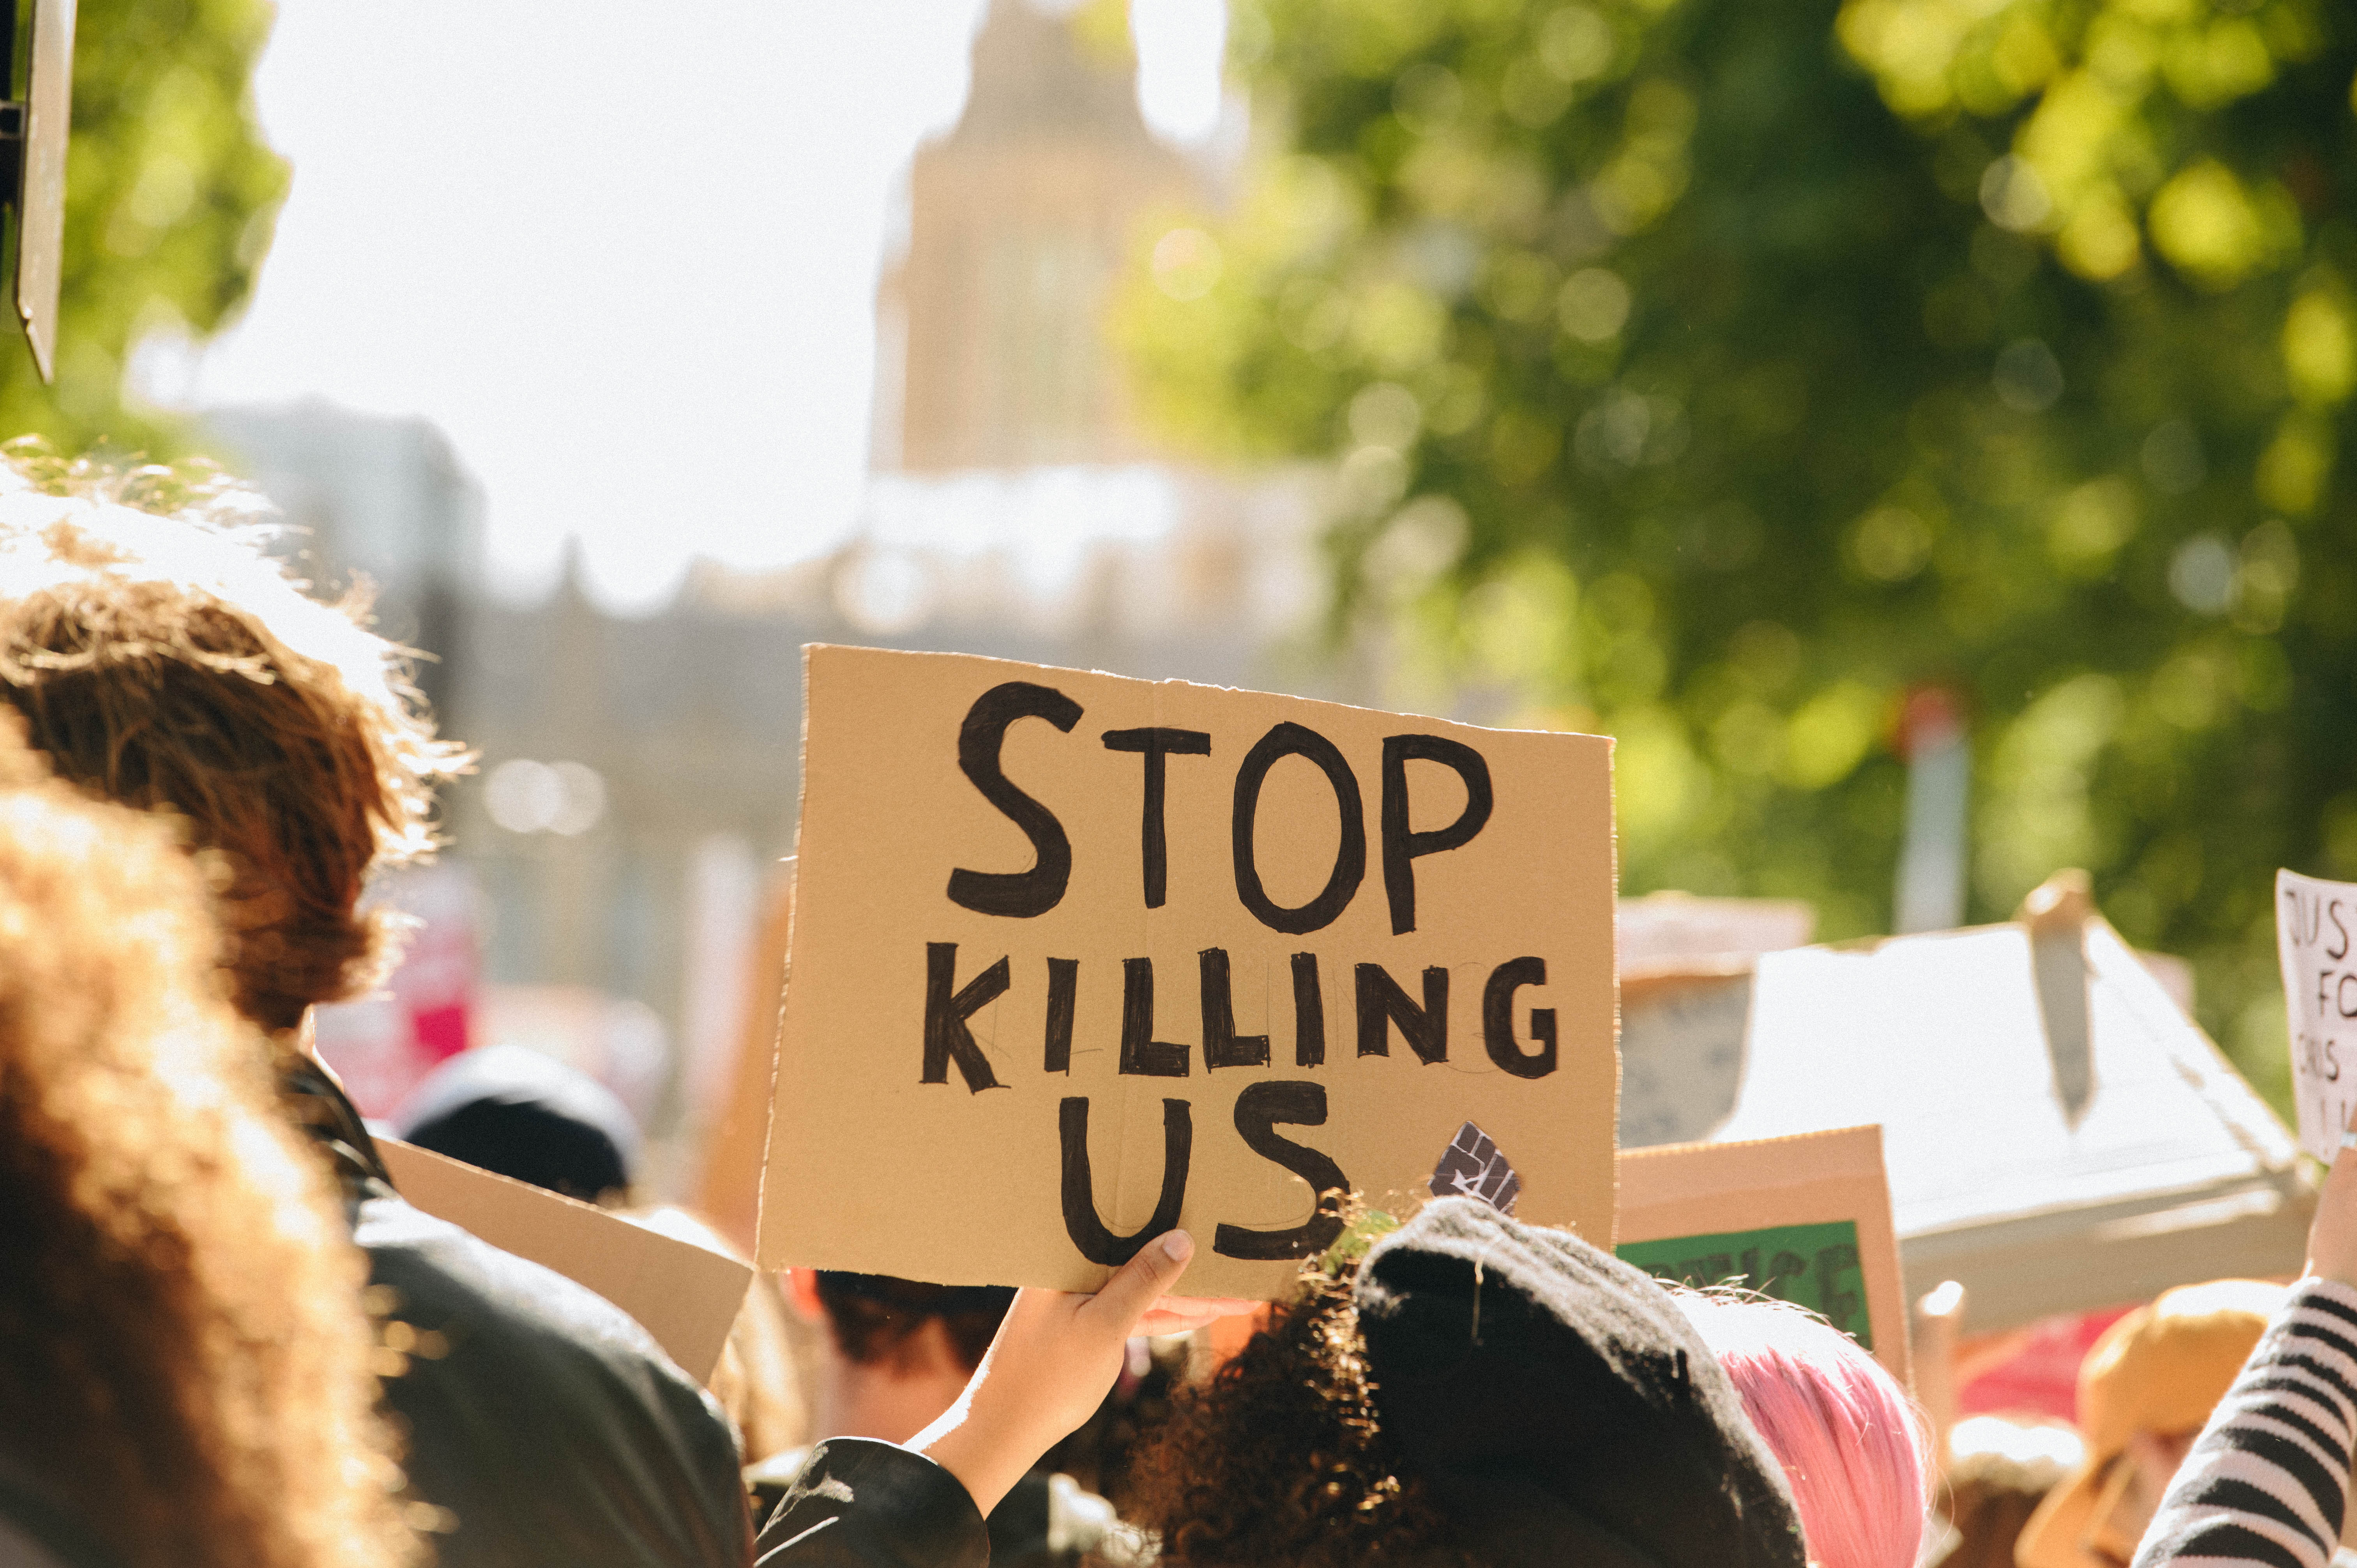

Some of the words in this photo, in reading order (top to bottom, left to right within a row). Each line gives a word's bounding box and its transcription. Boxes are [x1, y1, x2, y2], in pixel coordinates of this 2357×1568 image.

[947, 682, 1493, 936] STOP
[2283, 887, 2357, 965] JUS
[920, 942, 1557, 1093] KILLING
[1059, 1082, 1350, 1265] US
[1640, 1241, 1872, 1352] TICE
